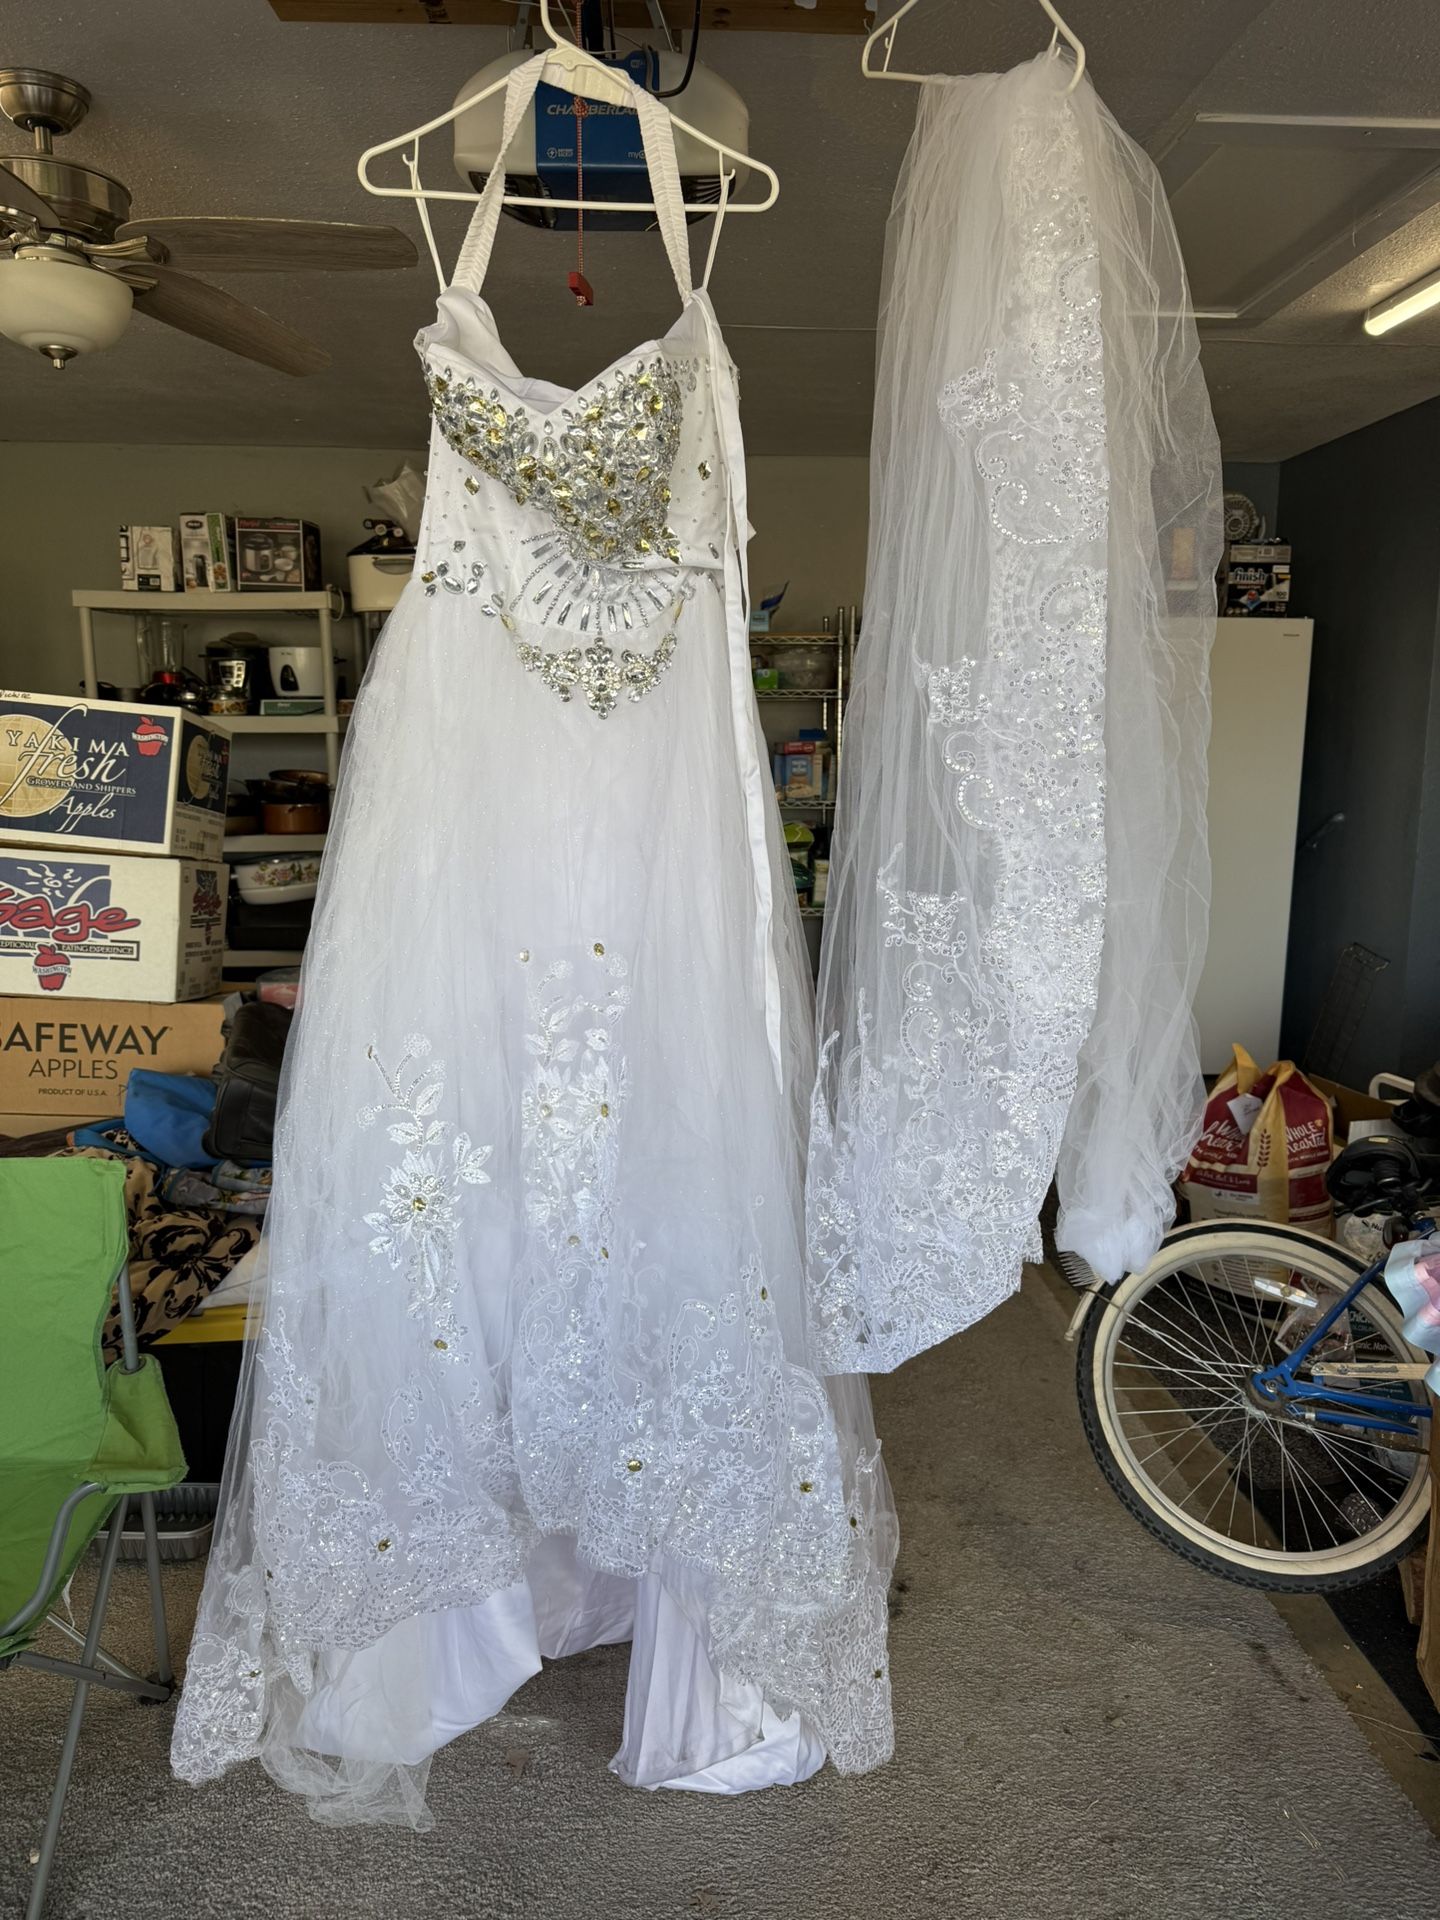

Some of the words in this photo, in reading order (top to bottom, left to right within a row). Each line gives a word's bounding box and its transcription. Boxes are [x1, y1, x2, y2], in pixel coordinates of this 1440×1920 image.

[0, 703, 127, 806] fresh
[6, 730, 130, 757] YAKIMA
[26, 775, 72, 789] GROWERS
[73, 781, 93, 791] AND
[94, 782, 137, 795] SHIPPERS
[49, 792, 117, 833] Apples
[62, 945, 88, 953] EATING
[89, 947, 133, 955] EXPERIENCE
[32, 965, 72, 975] WASHINGTON
[0, 1021, 169, 1056] AFEWAY
[28, 1058, 118, 1080] APPLES
